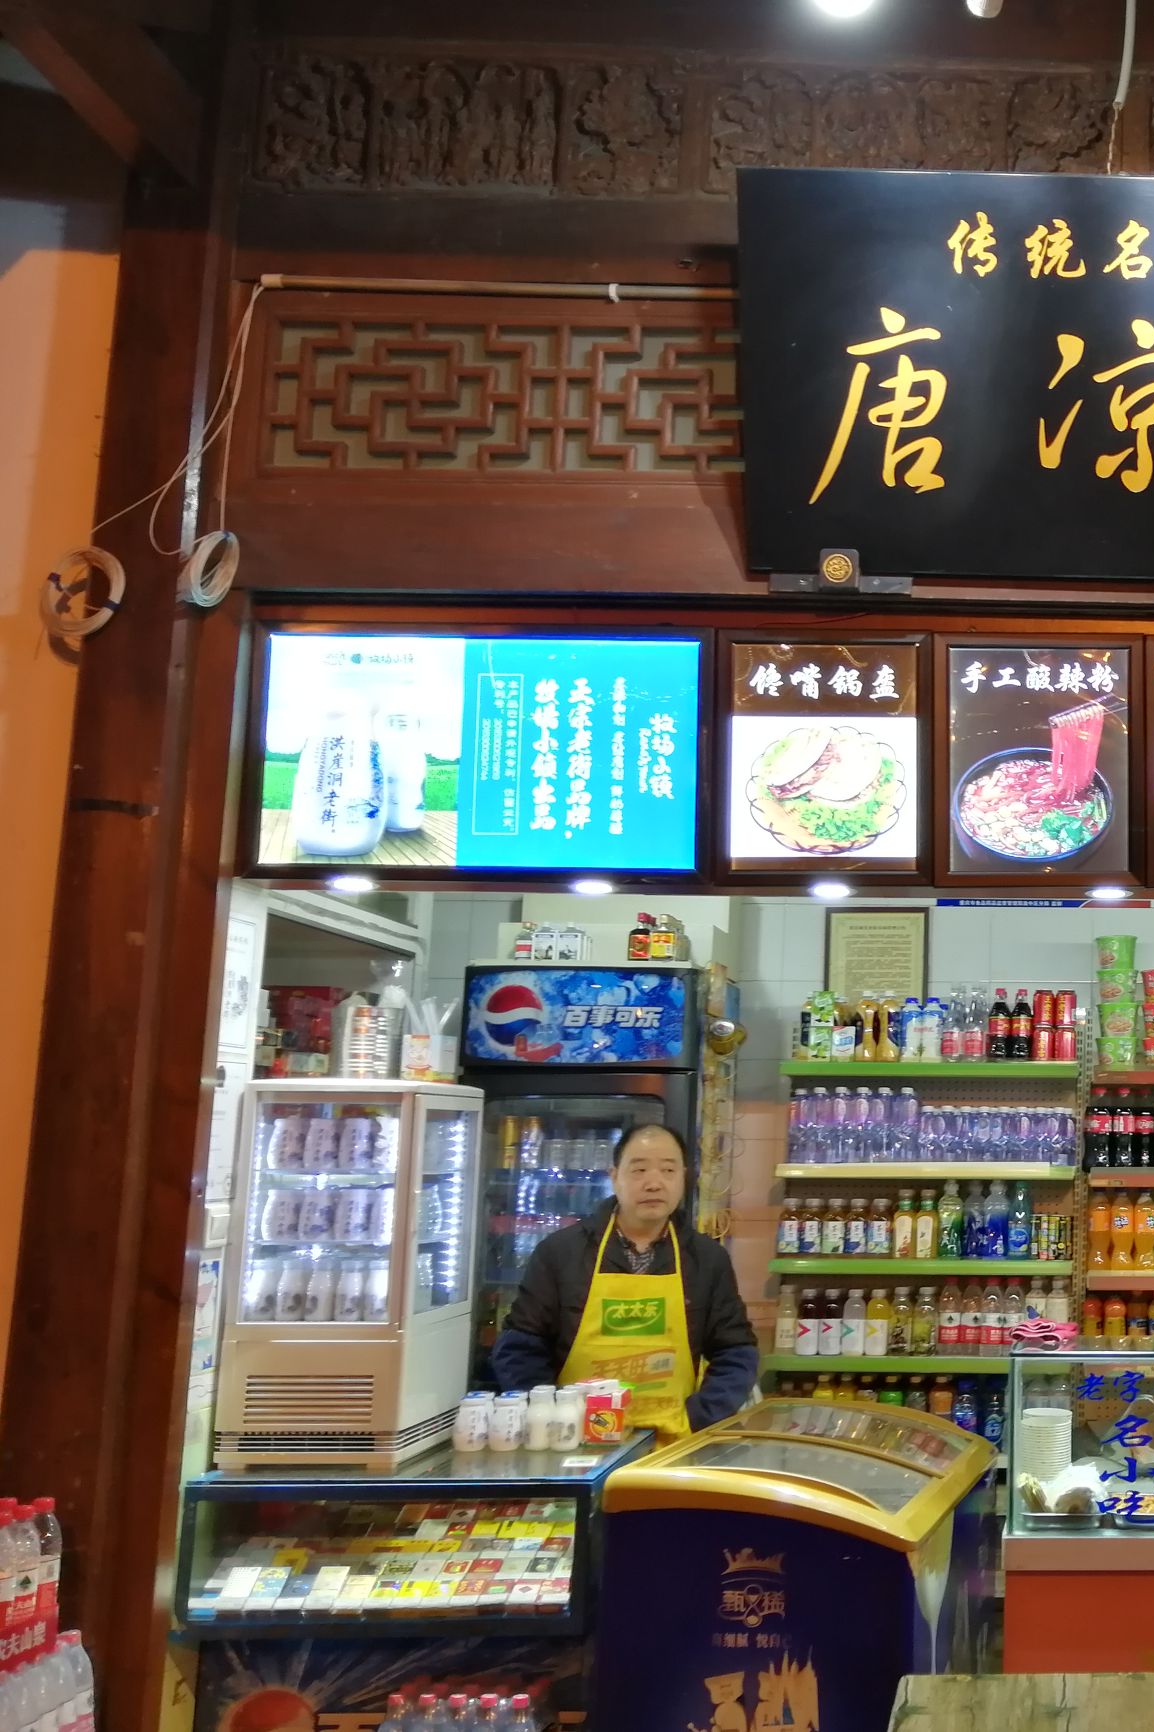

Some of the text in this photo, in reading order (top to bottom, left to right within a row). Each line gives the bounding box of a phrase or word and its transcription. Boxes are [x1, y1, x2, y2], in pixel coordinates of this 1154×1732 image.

[749, 662, 900, 700] 馋嘴锅盔
[960, 660, 1120, 694] 手工酸辣粉
[563, 1005, 664, 1028] 百事可乐
[611, 1301, 660, 1319] 太太乐
